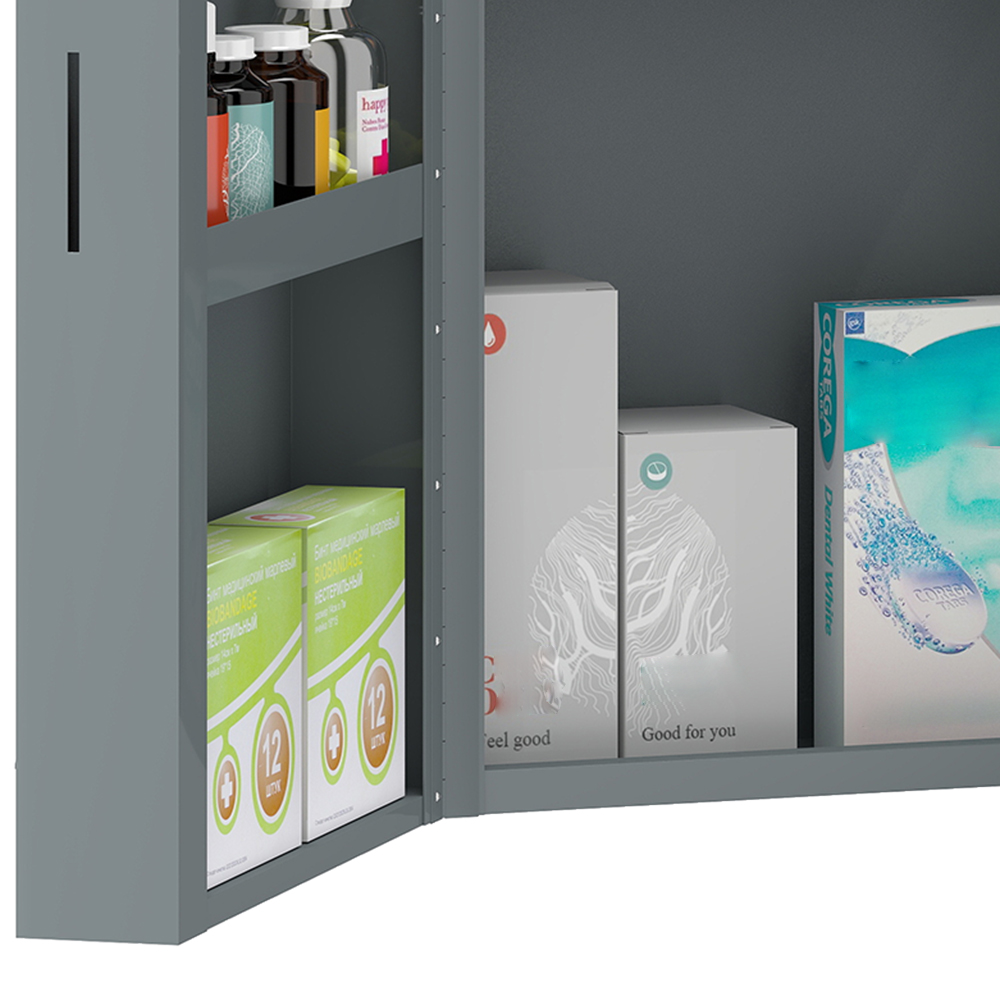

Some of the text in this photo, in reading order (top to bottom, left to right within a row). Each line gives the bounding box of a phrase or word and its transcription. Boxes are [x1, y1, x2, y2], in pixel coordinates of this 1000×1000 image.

[822, 312, 832, 438] COREGA
[824, 484, 834, 637] Dental White
[913, 582, 975, 603] COREGA
[368, 682, 386, 730] 12
[262, 729, 281, 777] 12
[484, 730, 551, 751] eel good
[642, 724, 736, 741] Good for you
